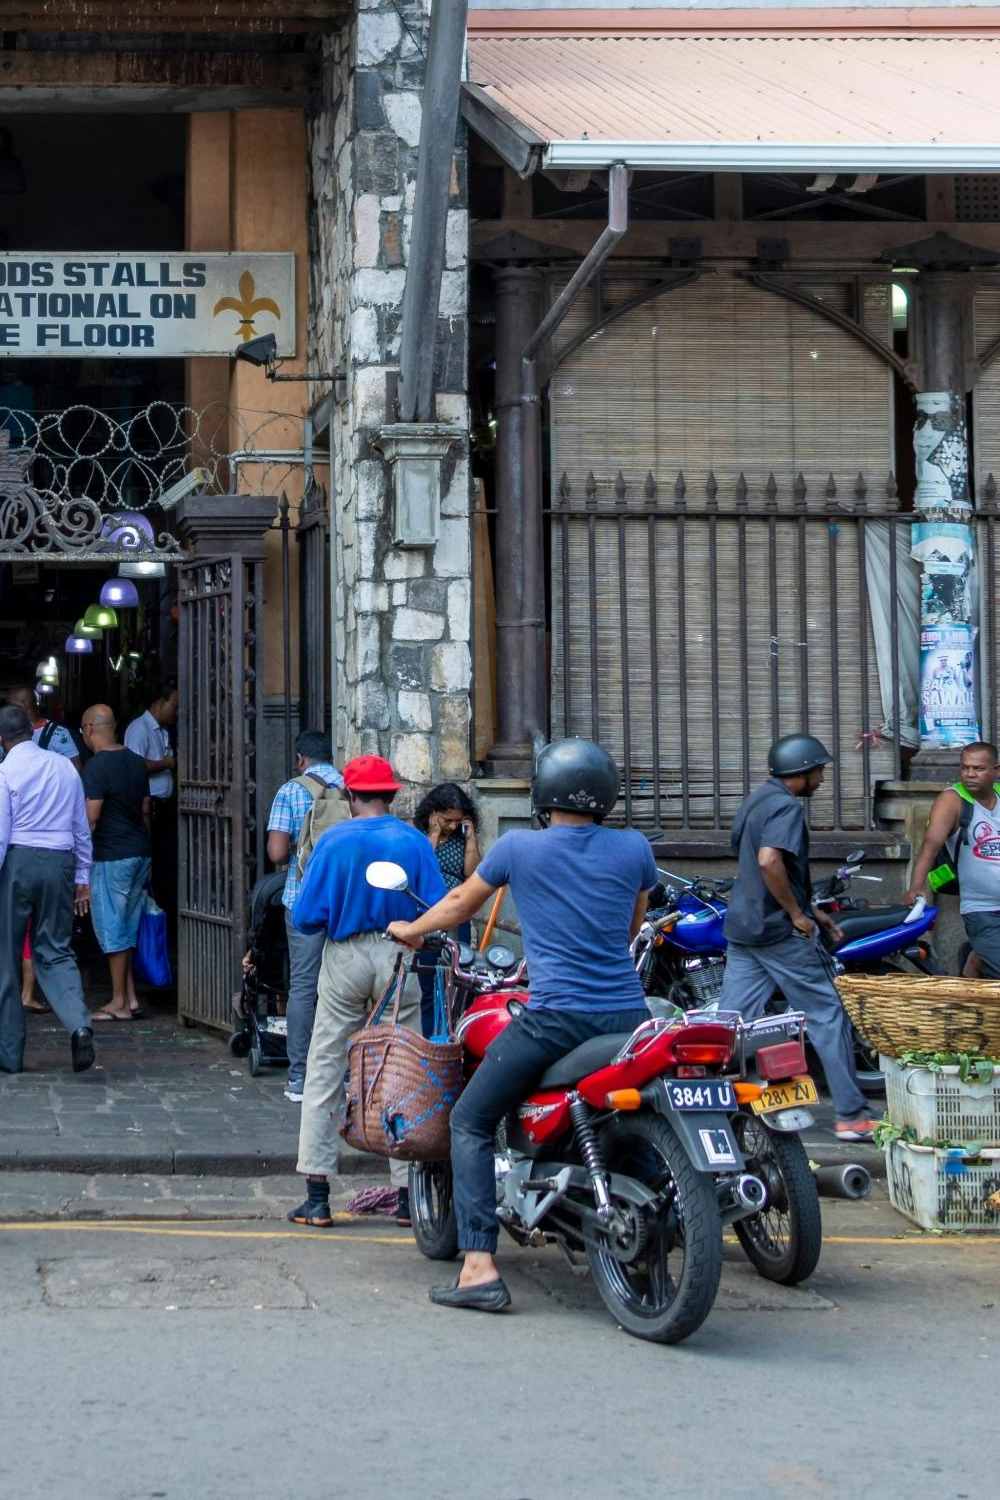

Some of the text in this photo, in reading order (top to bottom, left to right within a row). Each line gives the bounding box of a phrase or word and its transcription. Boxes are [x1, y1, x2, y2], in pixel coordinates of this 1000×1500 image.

[63, 262, 207, 288] STALLS
[150, 293, 196, 319] ON
[37, 324, 155, 347] FLOOR
[673, 1087, 731, 1106] 3841 U
[792, 1084, 810, 1101] ZV
